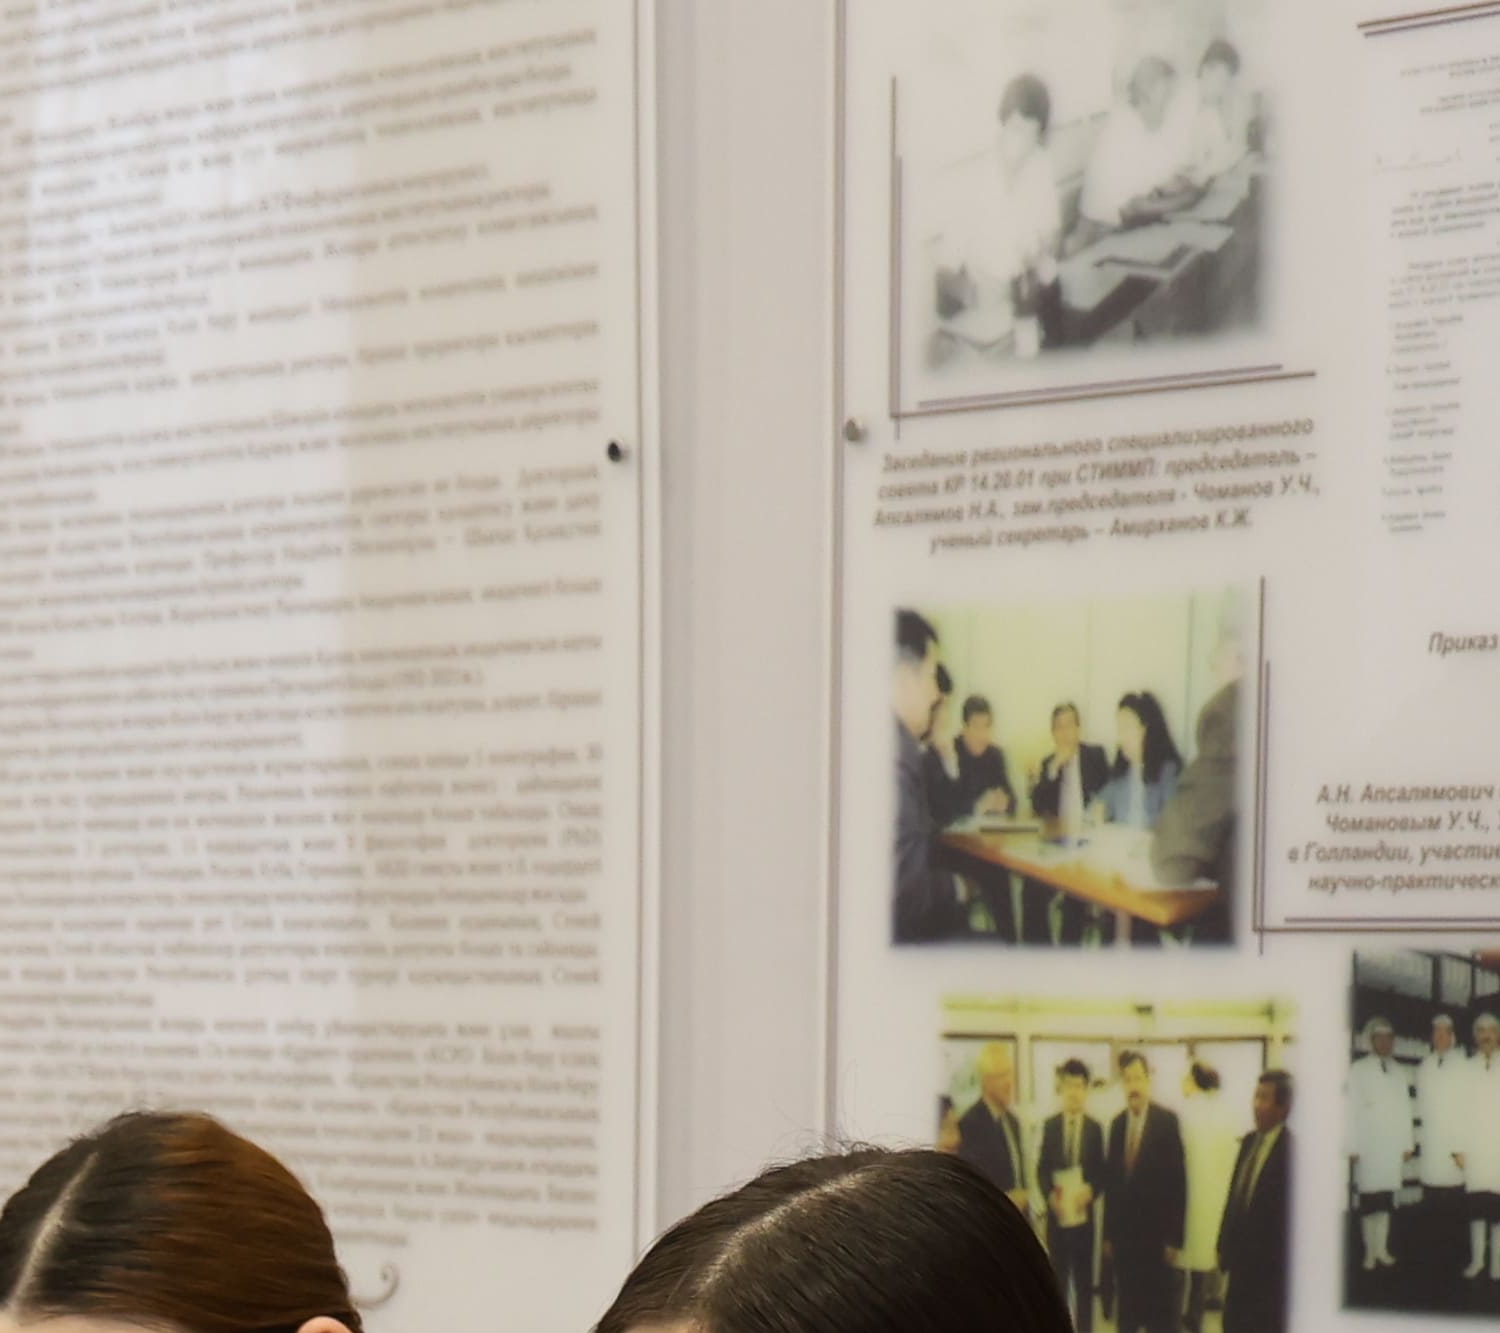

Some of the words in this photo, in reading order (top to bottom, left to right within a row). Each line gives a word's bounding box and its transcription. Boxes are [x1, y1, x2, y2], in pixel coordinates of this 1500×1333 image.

[1427, 631, 1499, 658] Приказ
[1359, 783, 1495, 804] Апсалямович
[1325, 813, 1443, 834] Чомановым
[1287, 846, 1300, 864] в
